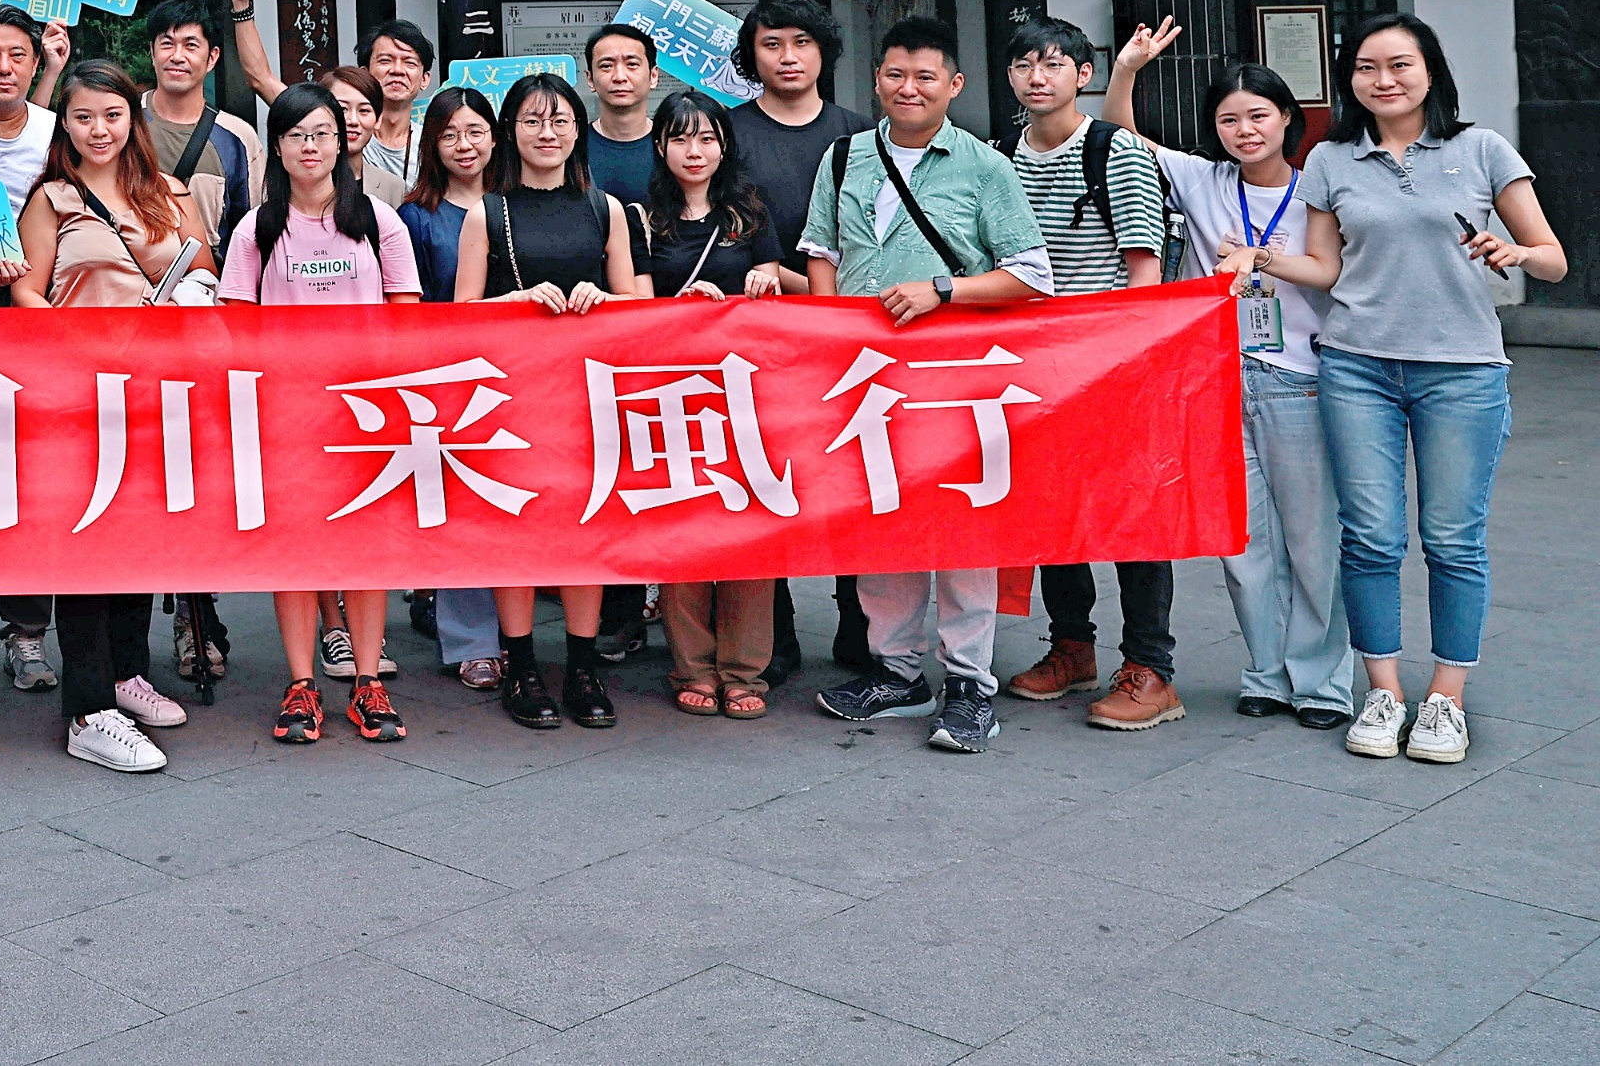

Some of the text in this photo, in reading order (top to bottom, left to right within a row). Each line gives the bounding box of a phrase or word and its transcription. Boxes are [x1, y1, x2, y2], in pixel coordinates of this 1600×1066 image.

[628, 12, 717, 74] 祠名天下
[292, 260, 352, 275] FASHION
